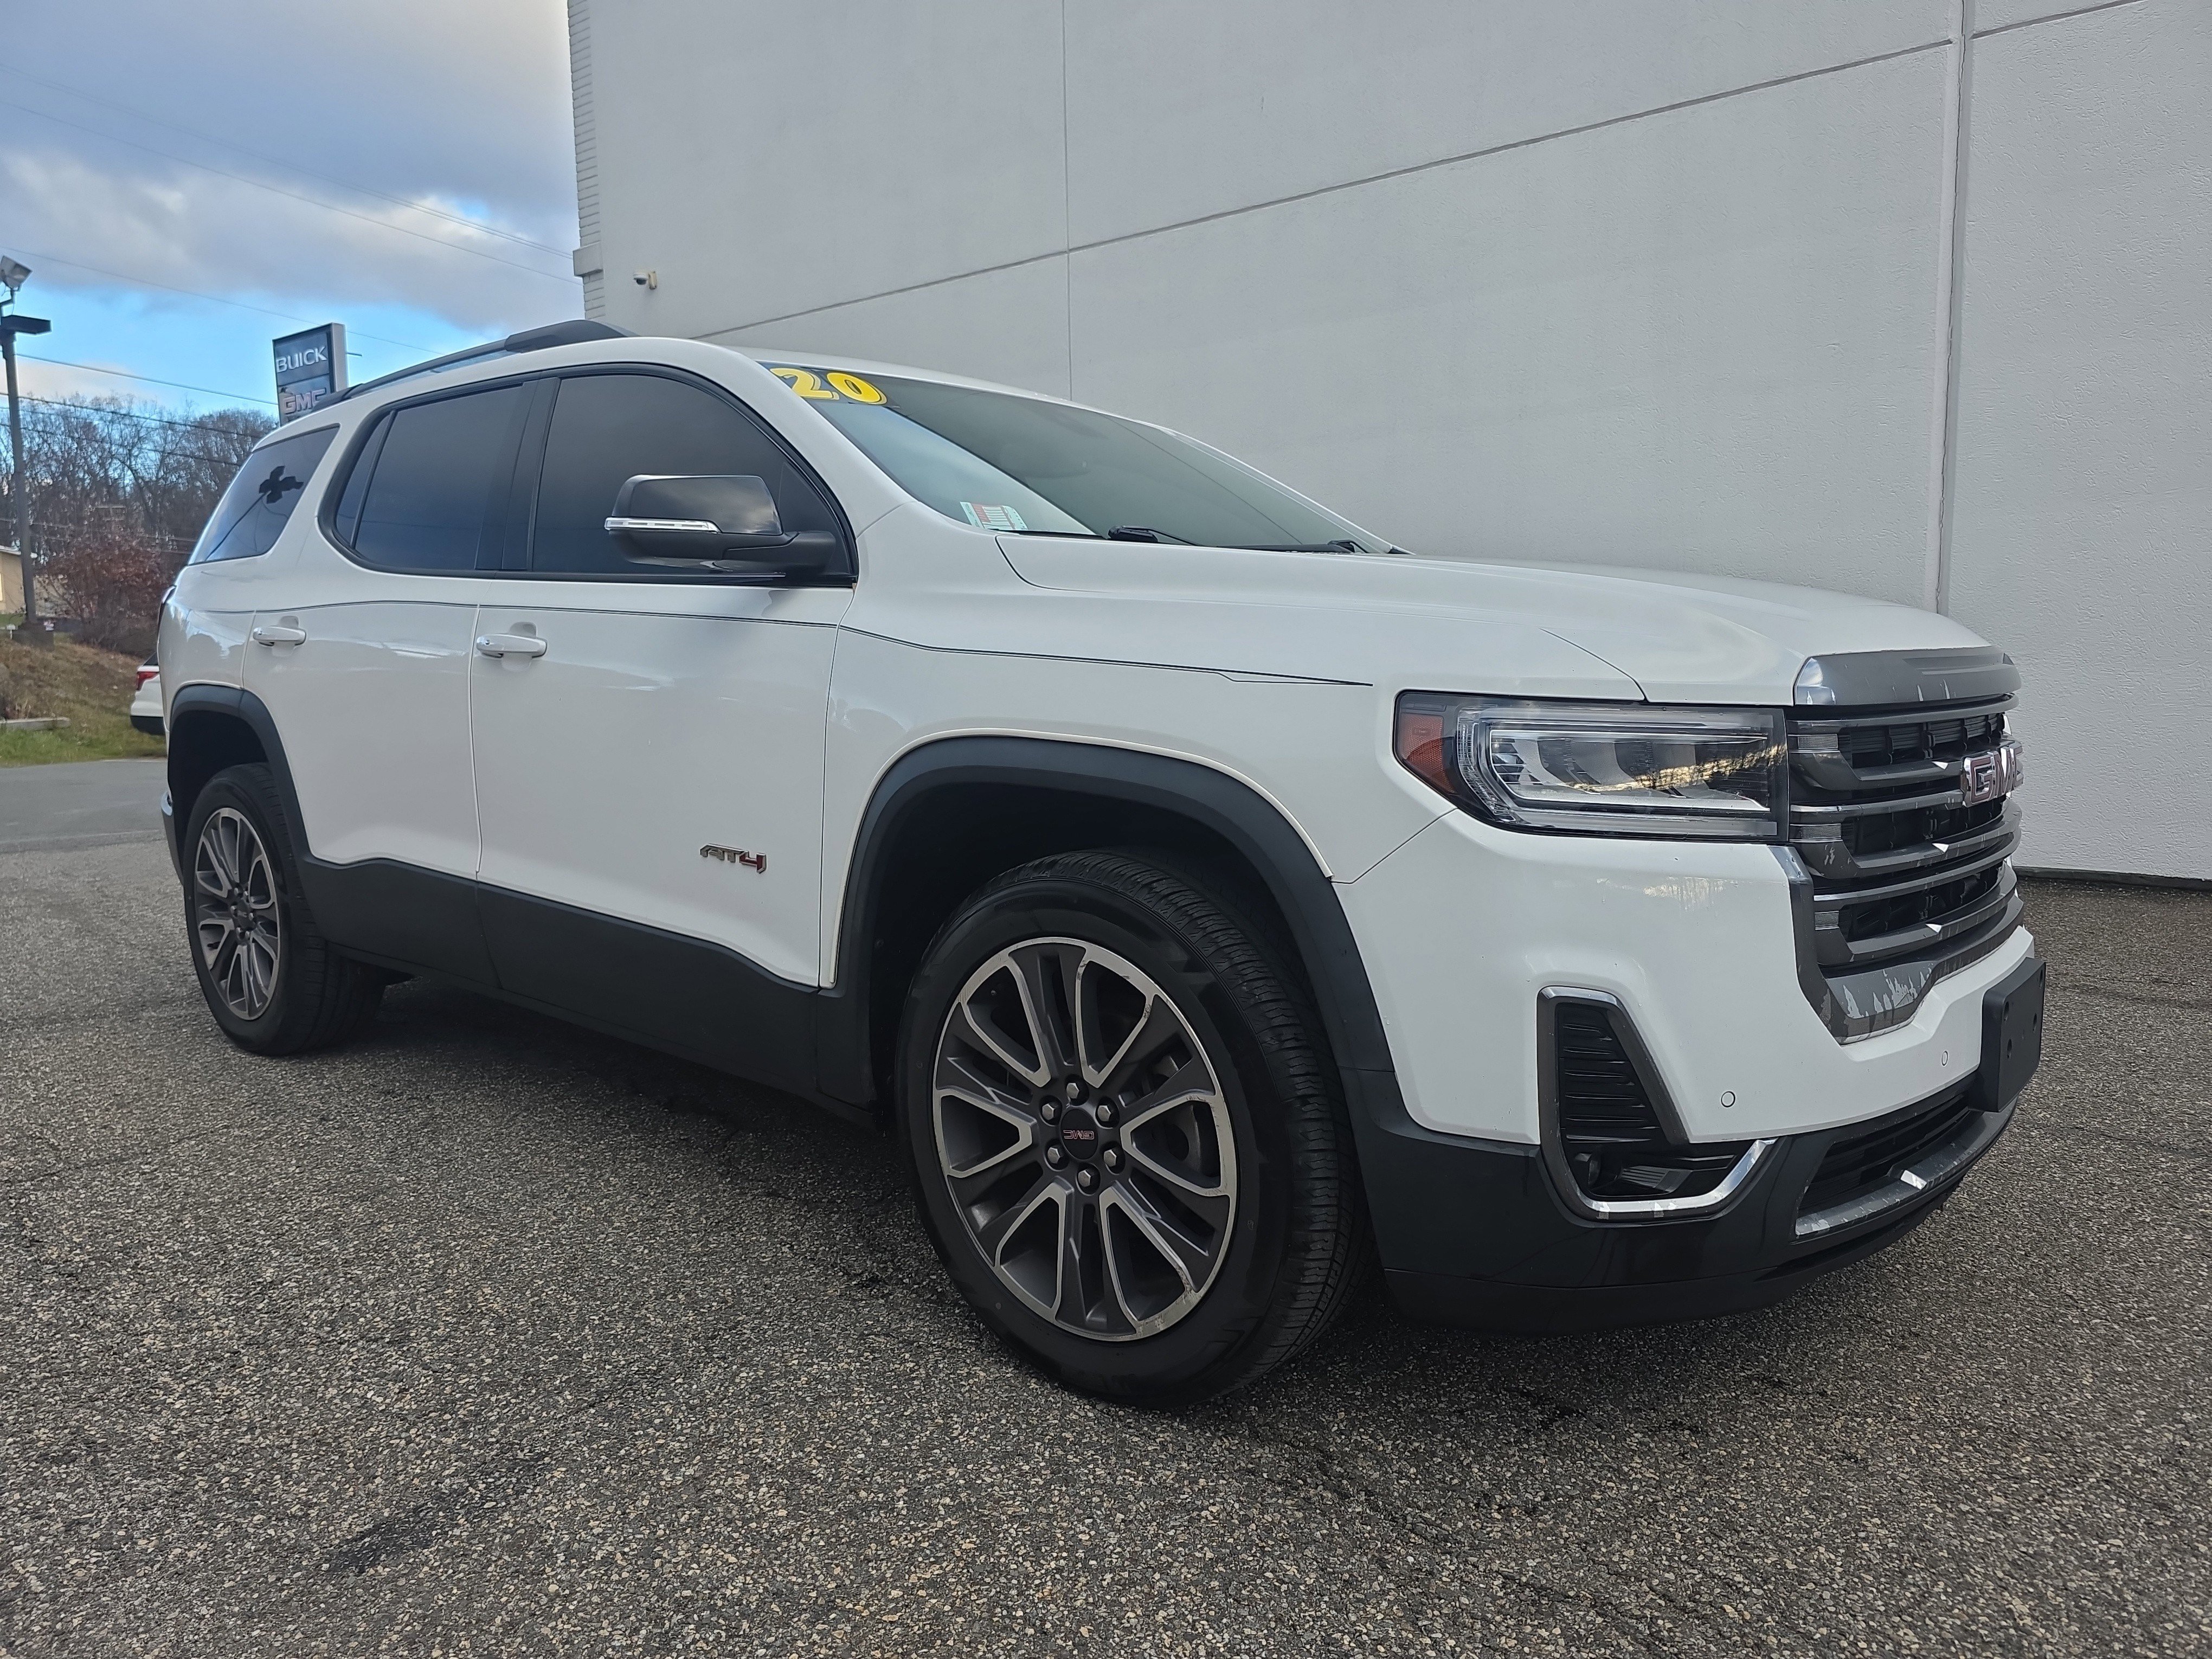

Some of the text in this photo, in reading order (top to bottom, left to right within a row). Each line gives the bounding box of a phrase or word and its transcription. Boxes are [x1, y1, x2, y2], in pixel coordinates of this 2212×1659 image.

[276, 346, 327, 373] BUICK
[769, 367, 888, 405] 20
[282, 388, 326, 414] GMC
[1963, 745, 2024, 807] GMC
[700, 843, 767, 874] AT4
[1063, 1129, 1095, 1140] GMC
